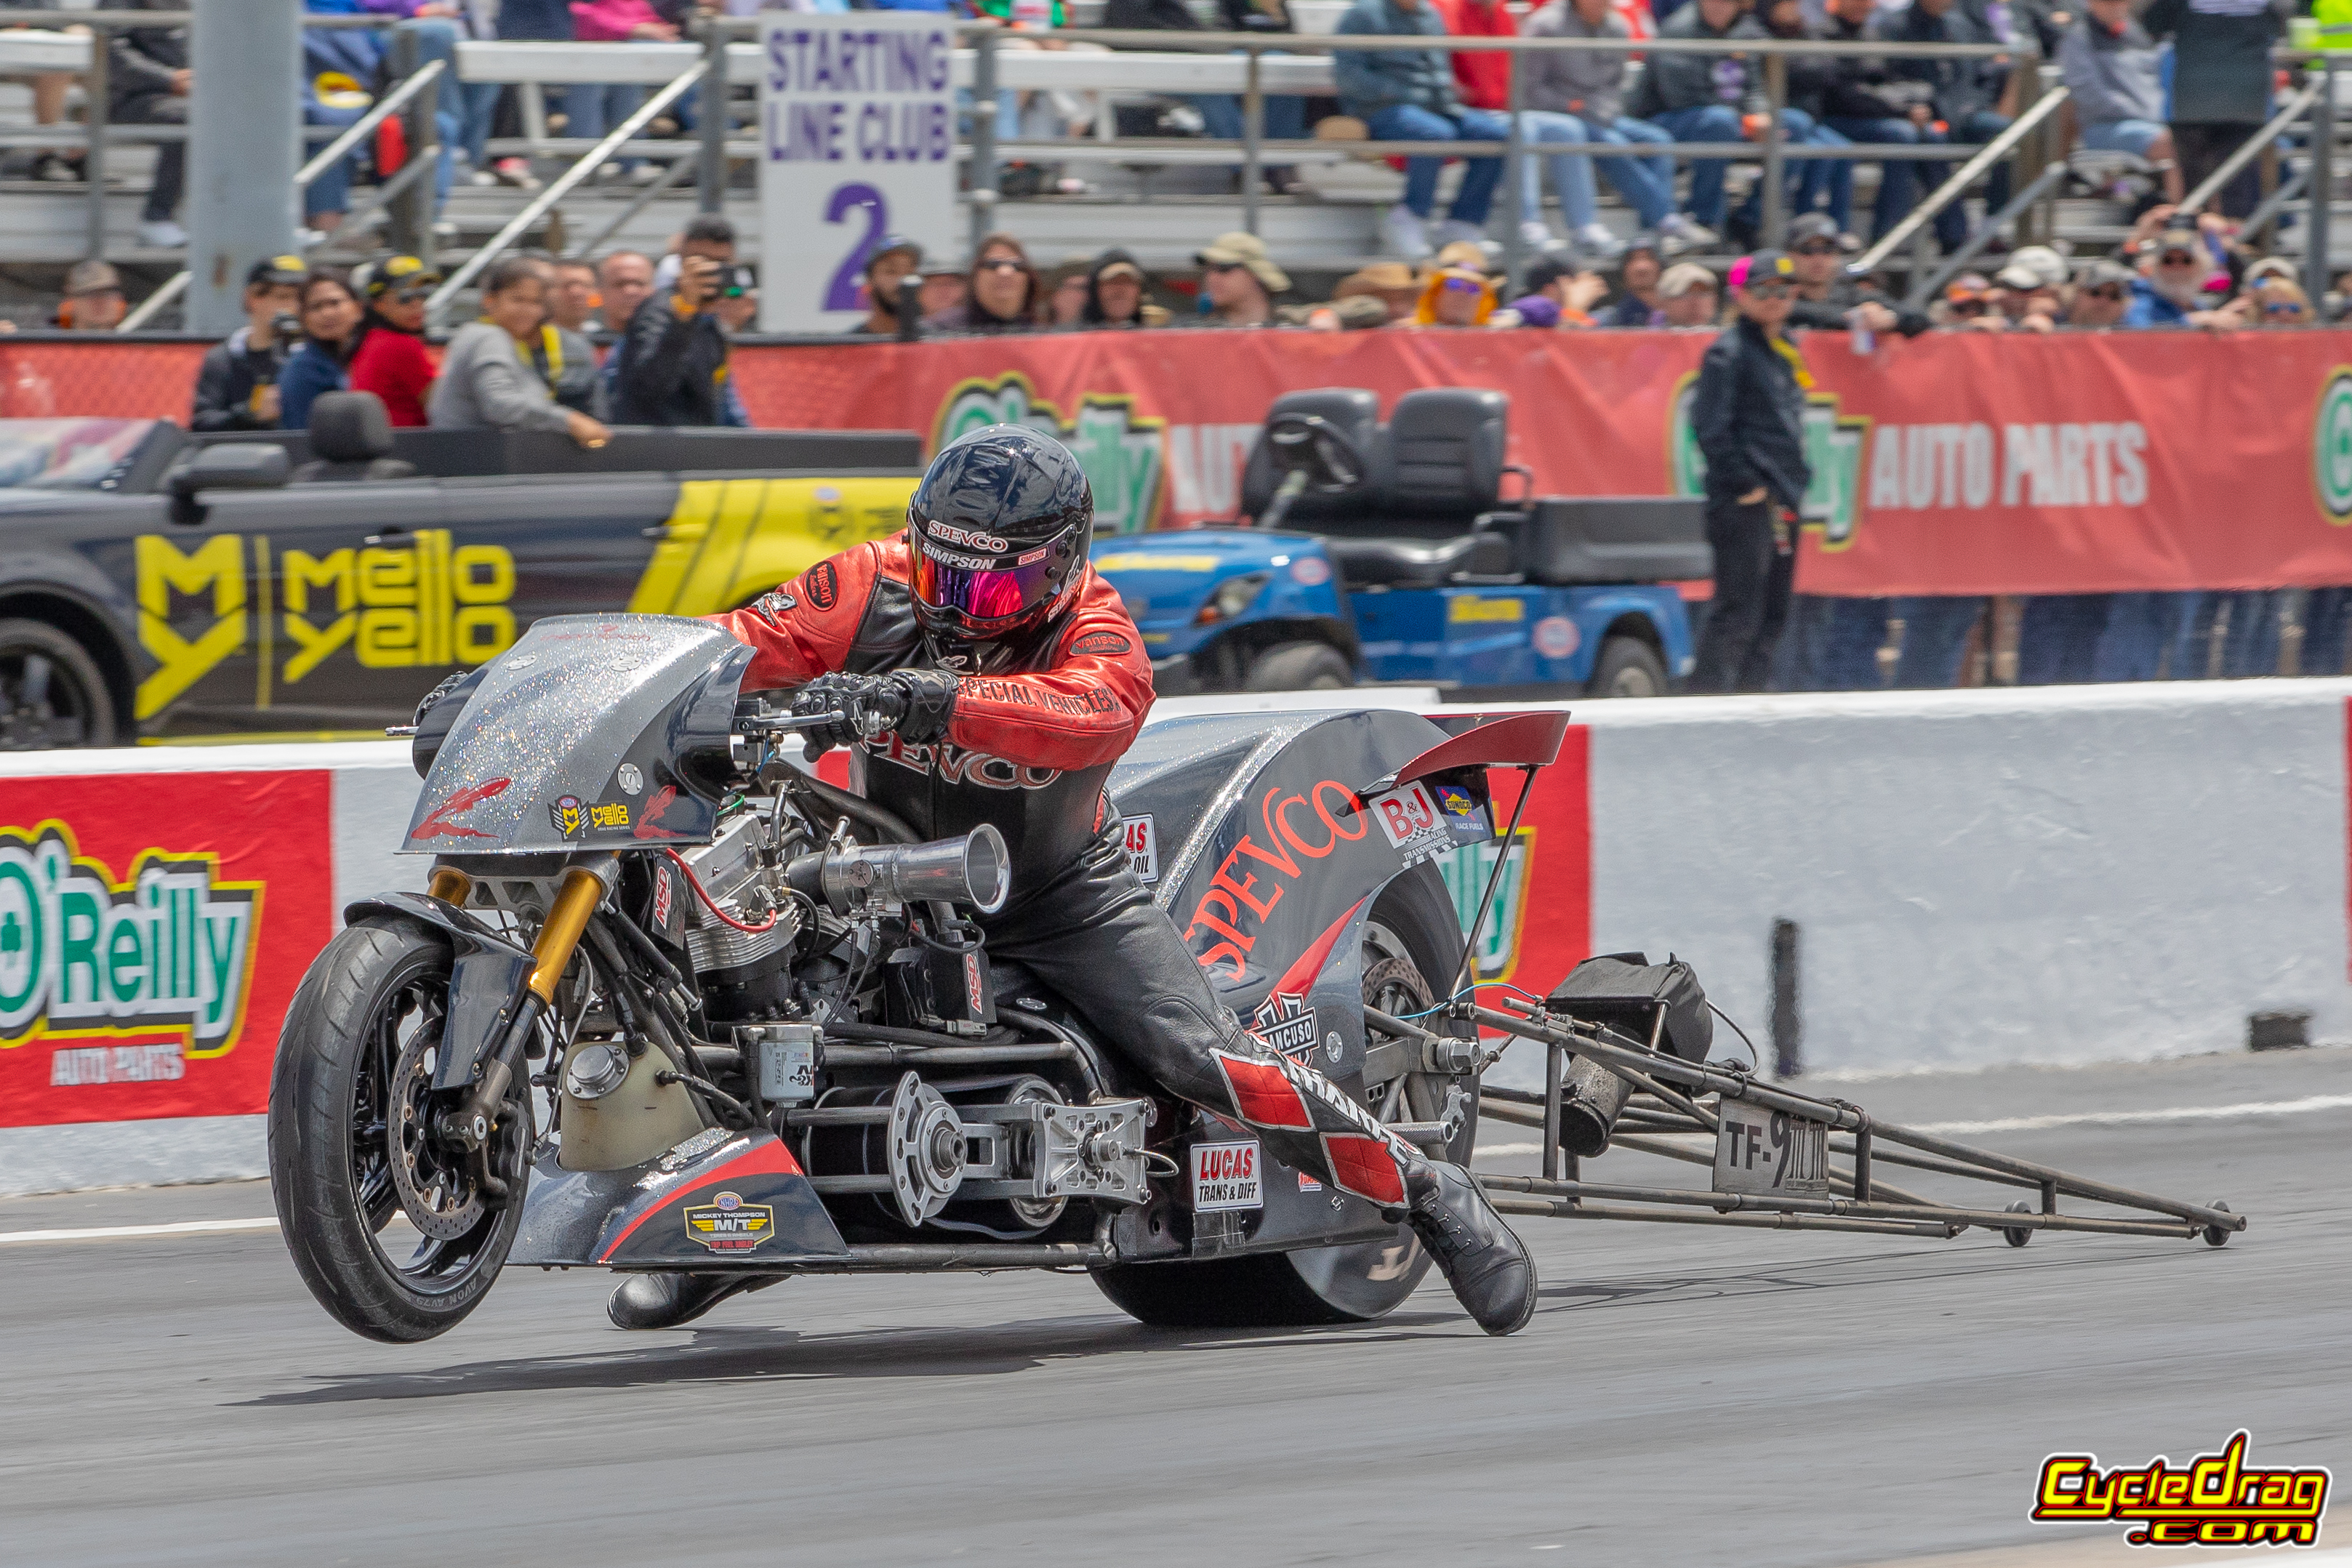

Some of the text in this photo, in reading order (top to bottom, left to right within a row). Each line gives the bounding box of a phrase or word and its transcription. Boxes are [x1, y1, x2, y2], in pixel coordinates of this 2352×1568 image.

[768, 28, 949, 92] STARTING
[768, 101, 948, 161] LINE CLUB
[820, 180, 888, 312] 2
[1869, 422, 1994, 510] AUTO
[2001, 422, 2148, 507] PARTS
[927, 520, 1008, 553] SPEVCO
[922, 542, 997, 570] SIMPSON
[958, 678, 1037, 706] SPECIAL
[1446, 800, 1472, 810] SUNOCO
[1426, 827, 1448, 842] RACING
[1469, 822, 1484, 831] FUELS
[1402, 835, 1451, 861] TRANSMISSIONS
[1133, 855, 1149, 875] OIL
[655, 866, 668, 930] MSD
[966, 953, 983, 1015] MSD
[1266, 1020, 1313, 1051] ANCUSO
[1200, 1147, 1254, 1181] LUCAS
[719, 1197, 739, 1207] NHRA
[1199, 1182, 1257, 1203] TRANS & DIFF
[713, 1218, 751, 1232] M/T
